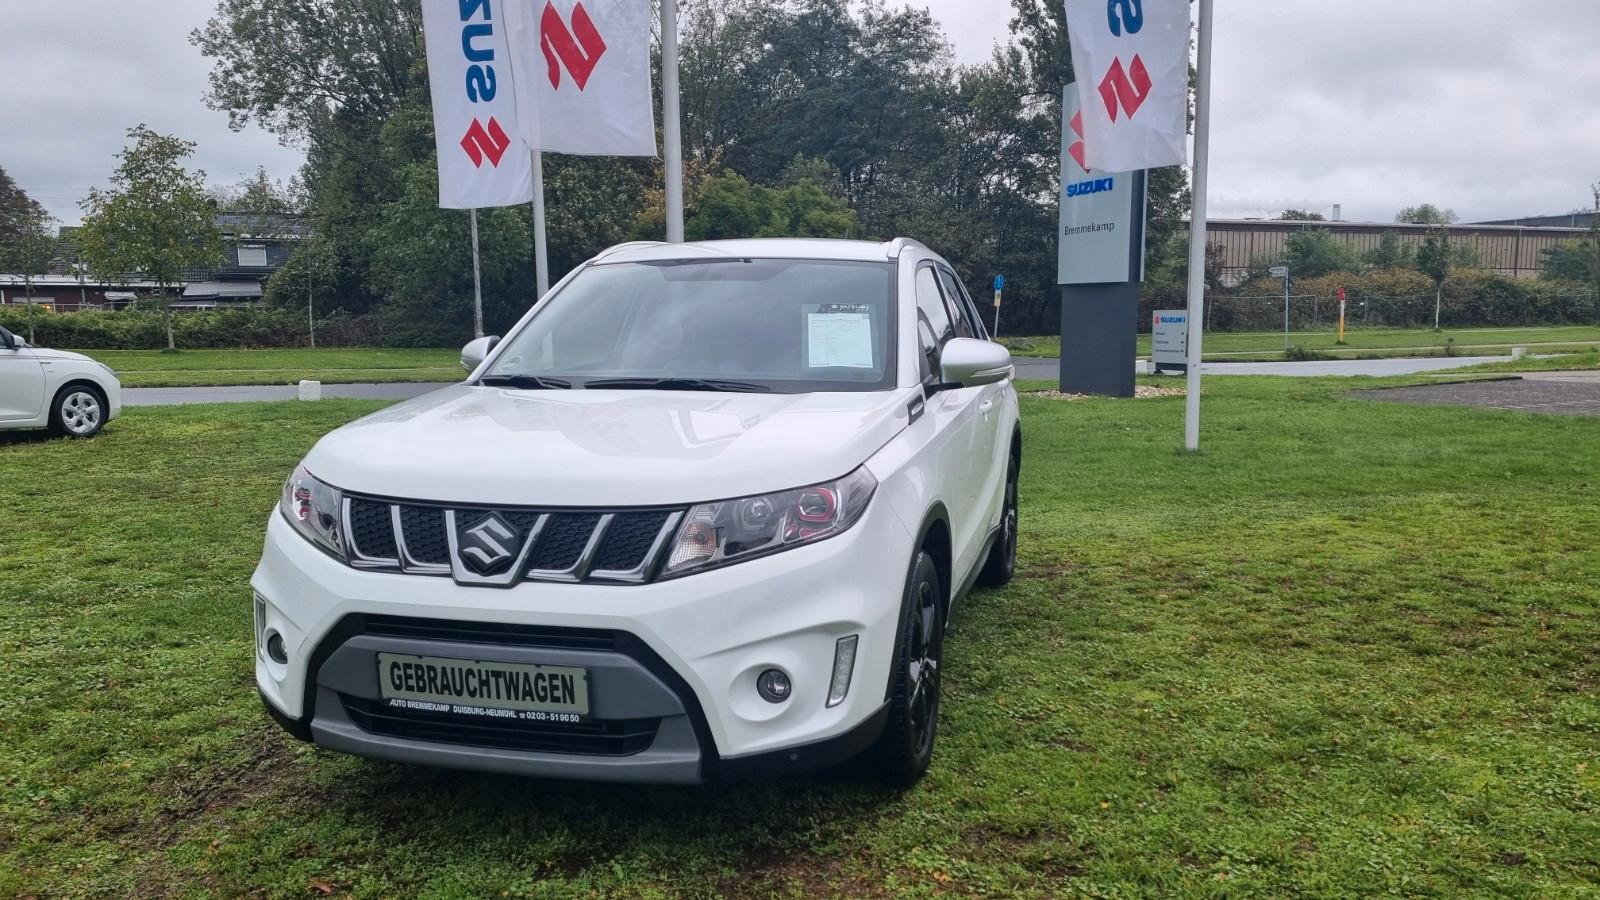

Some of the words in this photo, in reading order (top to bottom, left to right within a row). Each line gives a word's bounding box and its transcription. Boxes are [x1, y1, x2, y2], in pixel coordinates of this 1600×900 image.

[1066, 177, 1113, 198] SUZUKI
[1064, 221, 1115, 236] Bremmekamp
[1160, 316, 1186, 324] SUZUKI
[389, 660, 577, 705] GEBRAUCHTWAGEN
[389, 698, 407, 708] AUTO
[407, 700, 450, 712] BREMMEKAMP
